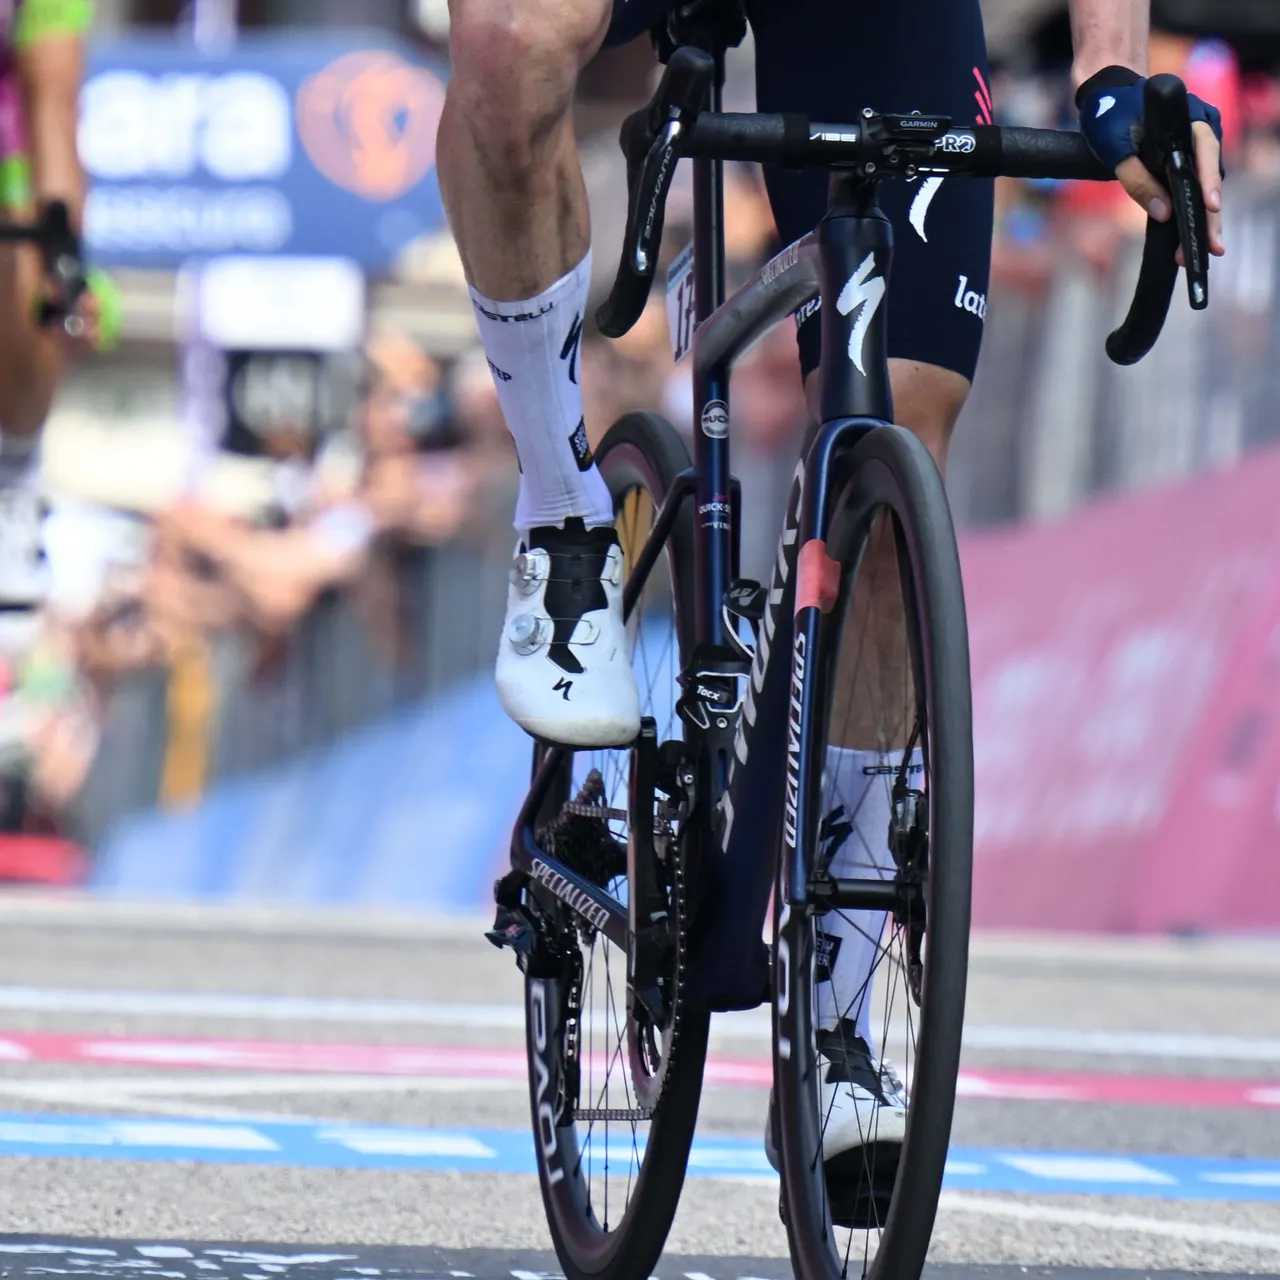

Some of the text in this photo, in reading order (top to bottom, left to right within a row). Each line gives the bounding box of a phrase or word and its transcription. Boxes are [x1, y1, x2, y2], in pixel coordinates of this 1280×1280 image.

[900, 120, 938, 129] GARMIN
[696, 684, 721, 701] Tacx
[783, 632, 807, 849] SPECIALIZED
[526, 858, 611, 929] SPECIALIZED
